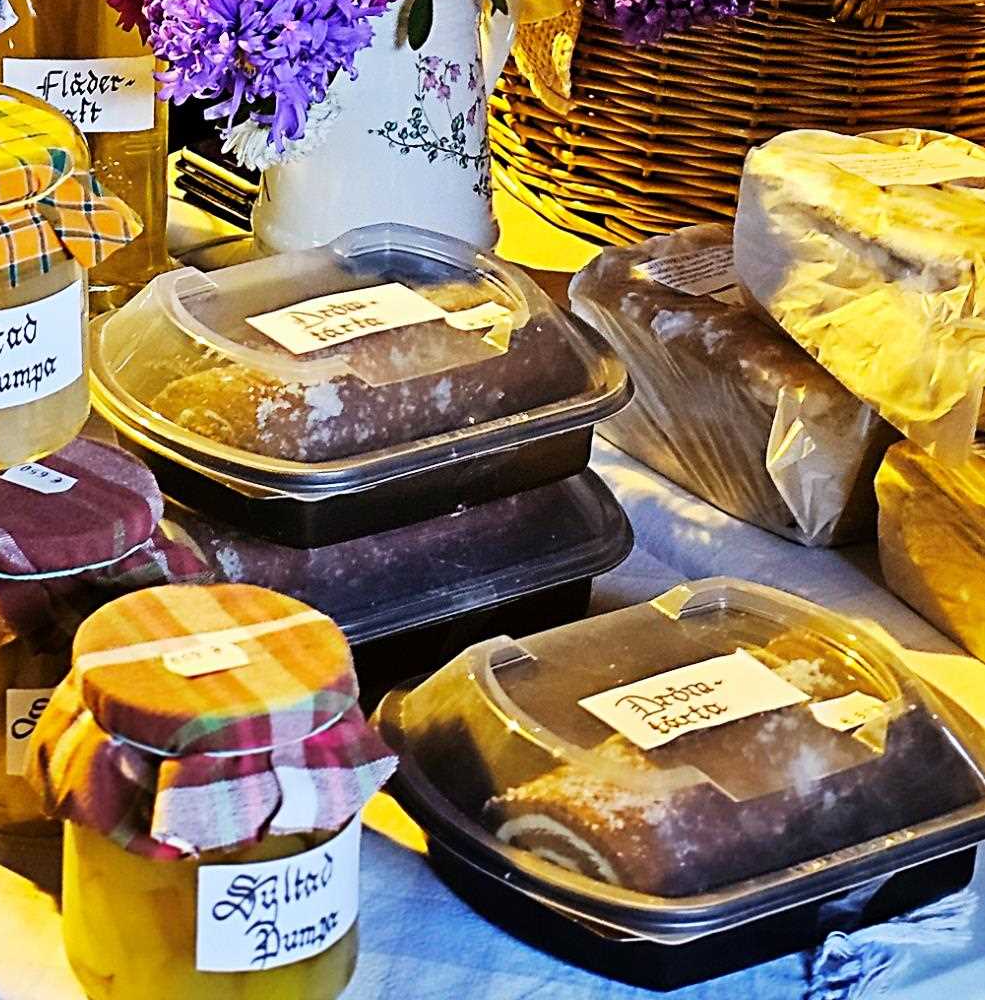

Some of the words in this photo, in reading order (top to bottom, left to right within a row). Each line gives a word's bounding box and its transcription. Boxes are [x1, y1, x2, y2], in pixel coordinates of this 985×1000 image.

[60, 96, 103, 124] aft
[212, 851, 334, 935] Syltad
[250, 911, 339, 969] Pumpa
